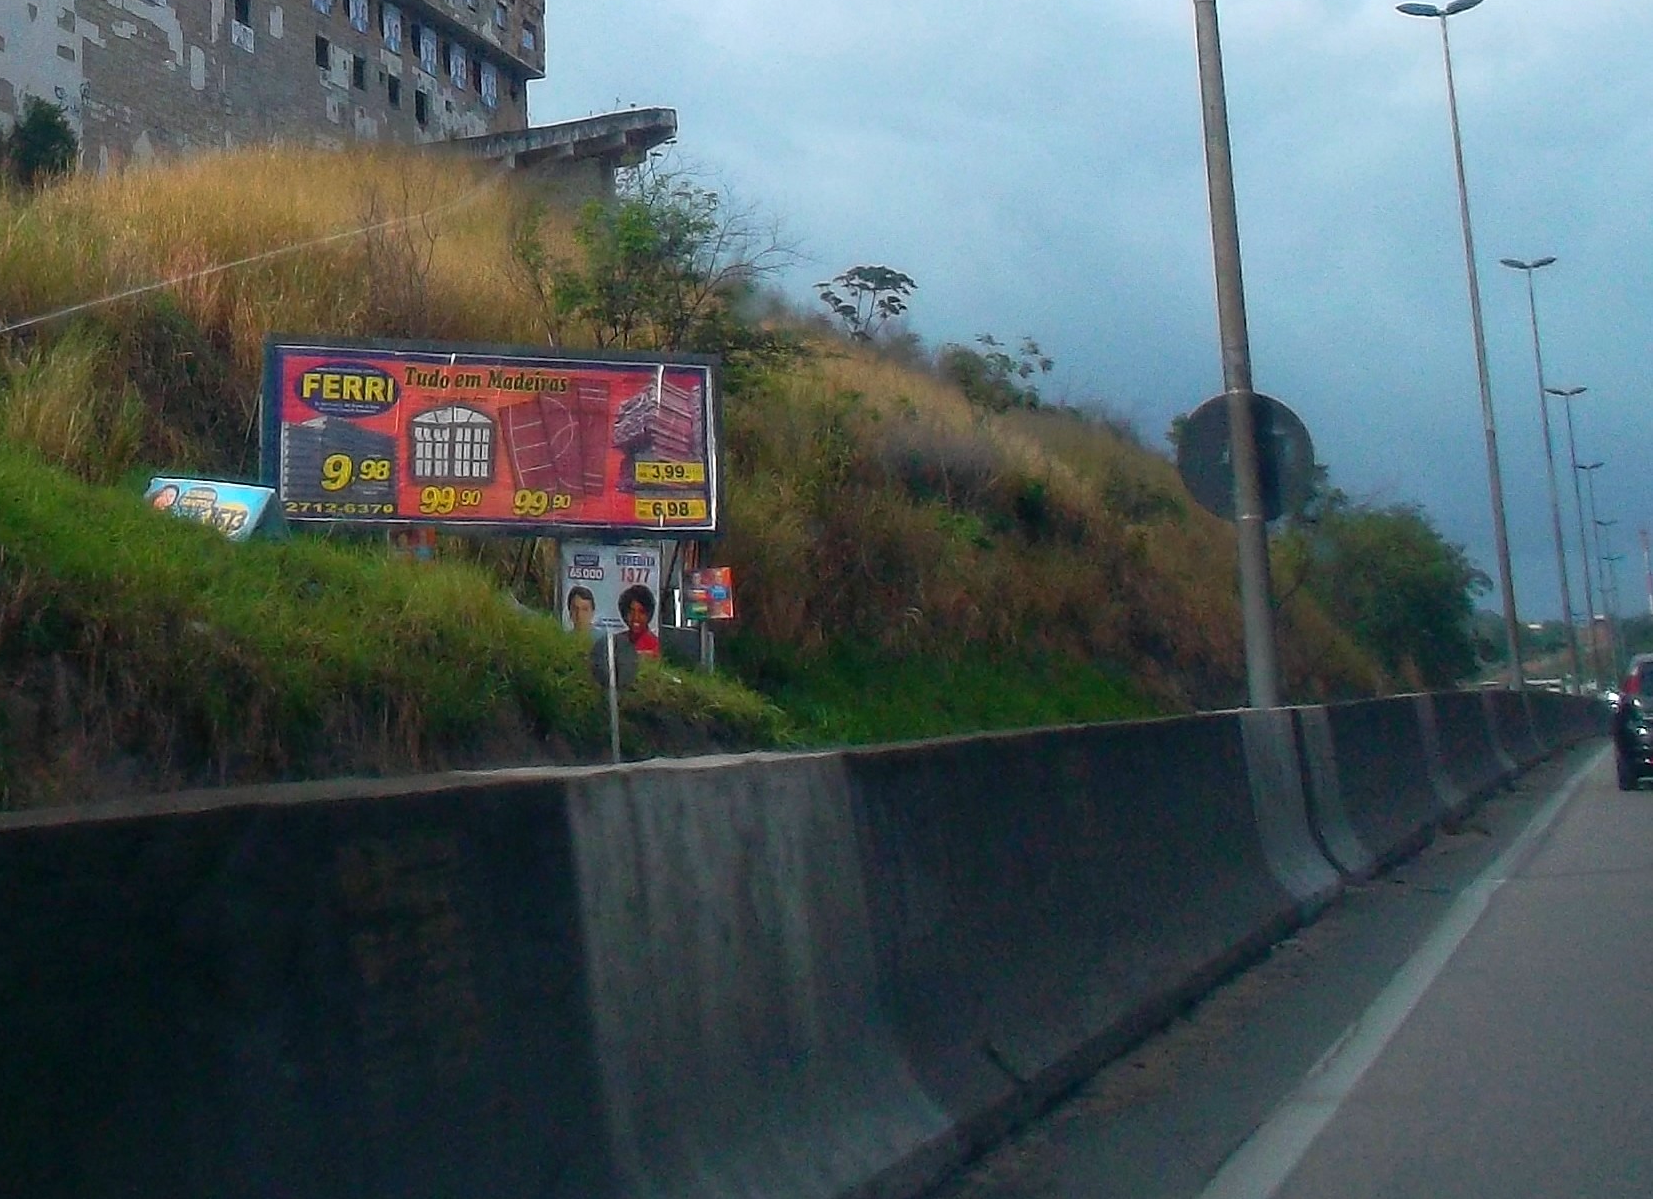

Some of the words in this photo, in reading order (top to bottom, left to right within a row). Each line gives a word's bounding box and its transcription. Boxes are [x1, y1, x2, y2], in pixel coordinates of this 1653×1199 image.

[302, 373, 395, 402] FERRI
[405, 366, 449, 389] Tudo
[455, 373, 481, 389] em
[488, 370, 568, 393] Madeiras
[621, 567, 650, 583] 1377
